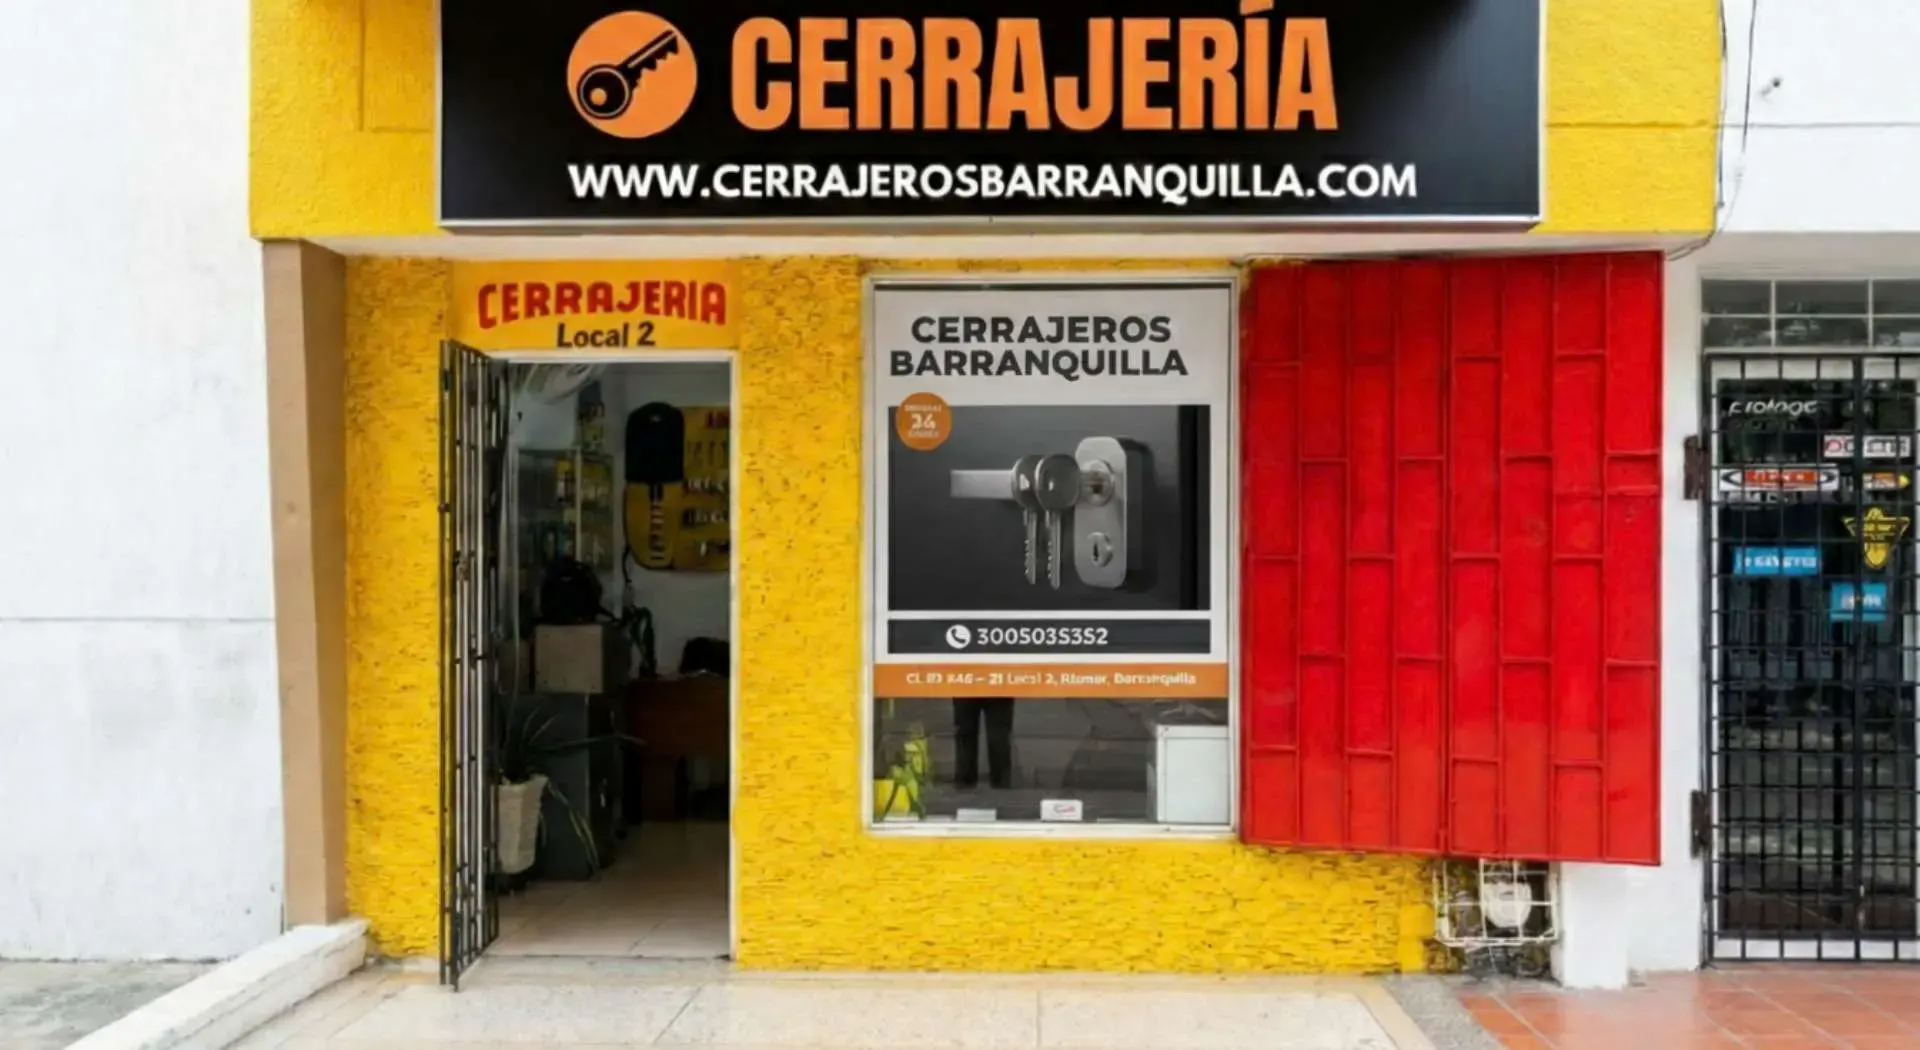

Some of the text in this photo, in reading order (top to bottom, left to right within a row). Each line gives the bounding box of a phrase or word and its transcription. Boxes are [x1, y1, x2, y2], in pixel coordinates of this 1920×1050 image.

[731, 0, 1338, 131] CERRAJERÍA
[568, 163, 1417, 206] WWW.CERRAJEROSBARRANQUILLA.COM
[478, 281, 727, 330] CERRAJERIA
[557, 321, 656, 348] Local 2
[911, 316, 1171, 344] CERRAJEROS
[890, 349, 1189, 382] BARRANQUILLA
[977, 627, 1109, 645] 3005035352
